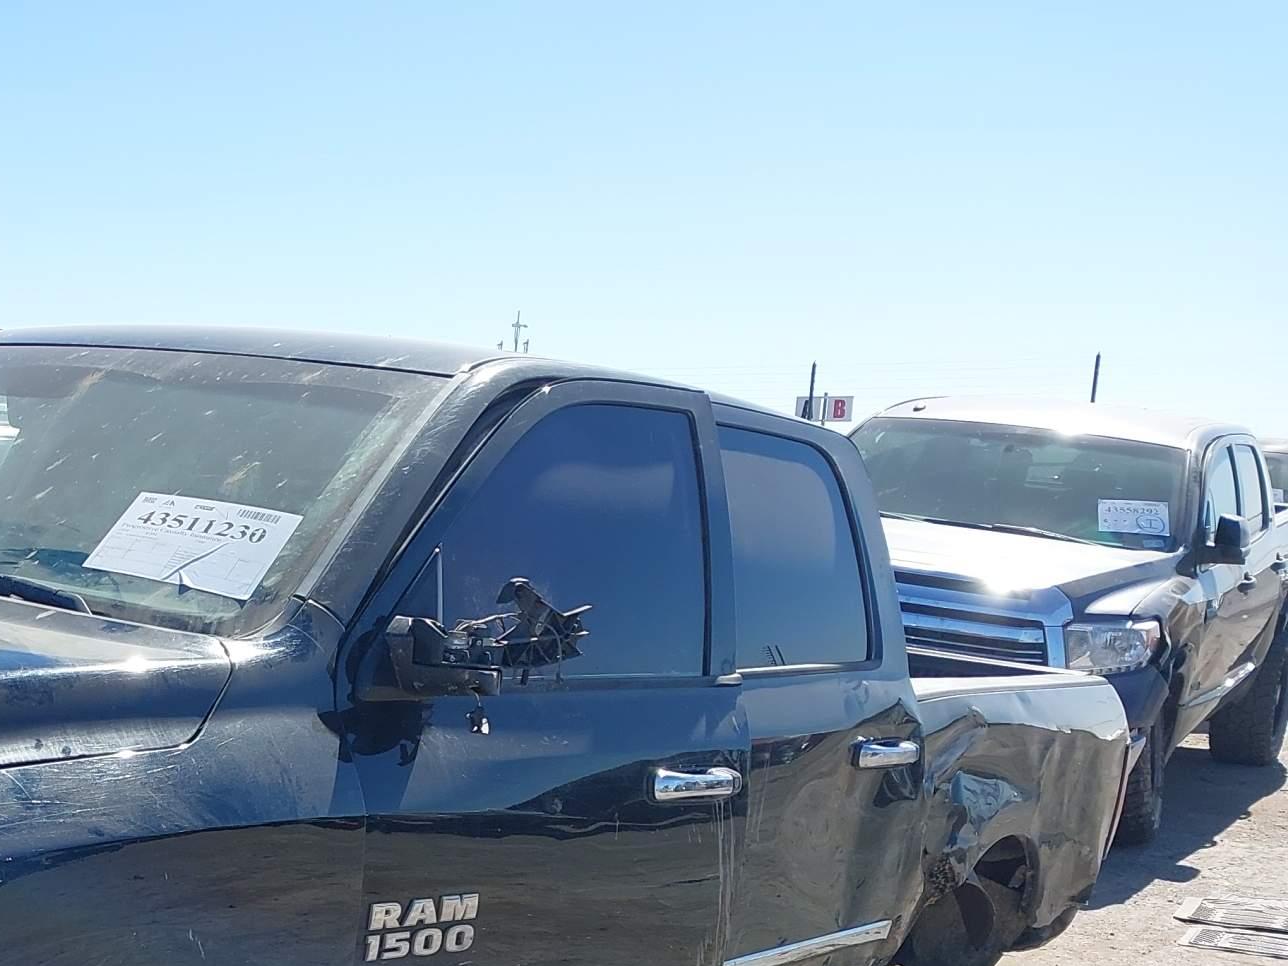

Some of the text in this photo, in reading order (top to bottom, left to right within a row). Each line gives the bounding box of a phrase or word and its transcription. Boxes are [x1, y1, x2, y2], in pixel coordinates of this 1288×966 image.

[833, 399, 846, 419] B
[136, 510, 268, 544] 43511230
[367, 892, 480, 931] RAM
[364, 923, 475, 962] 1500
